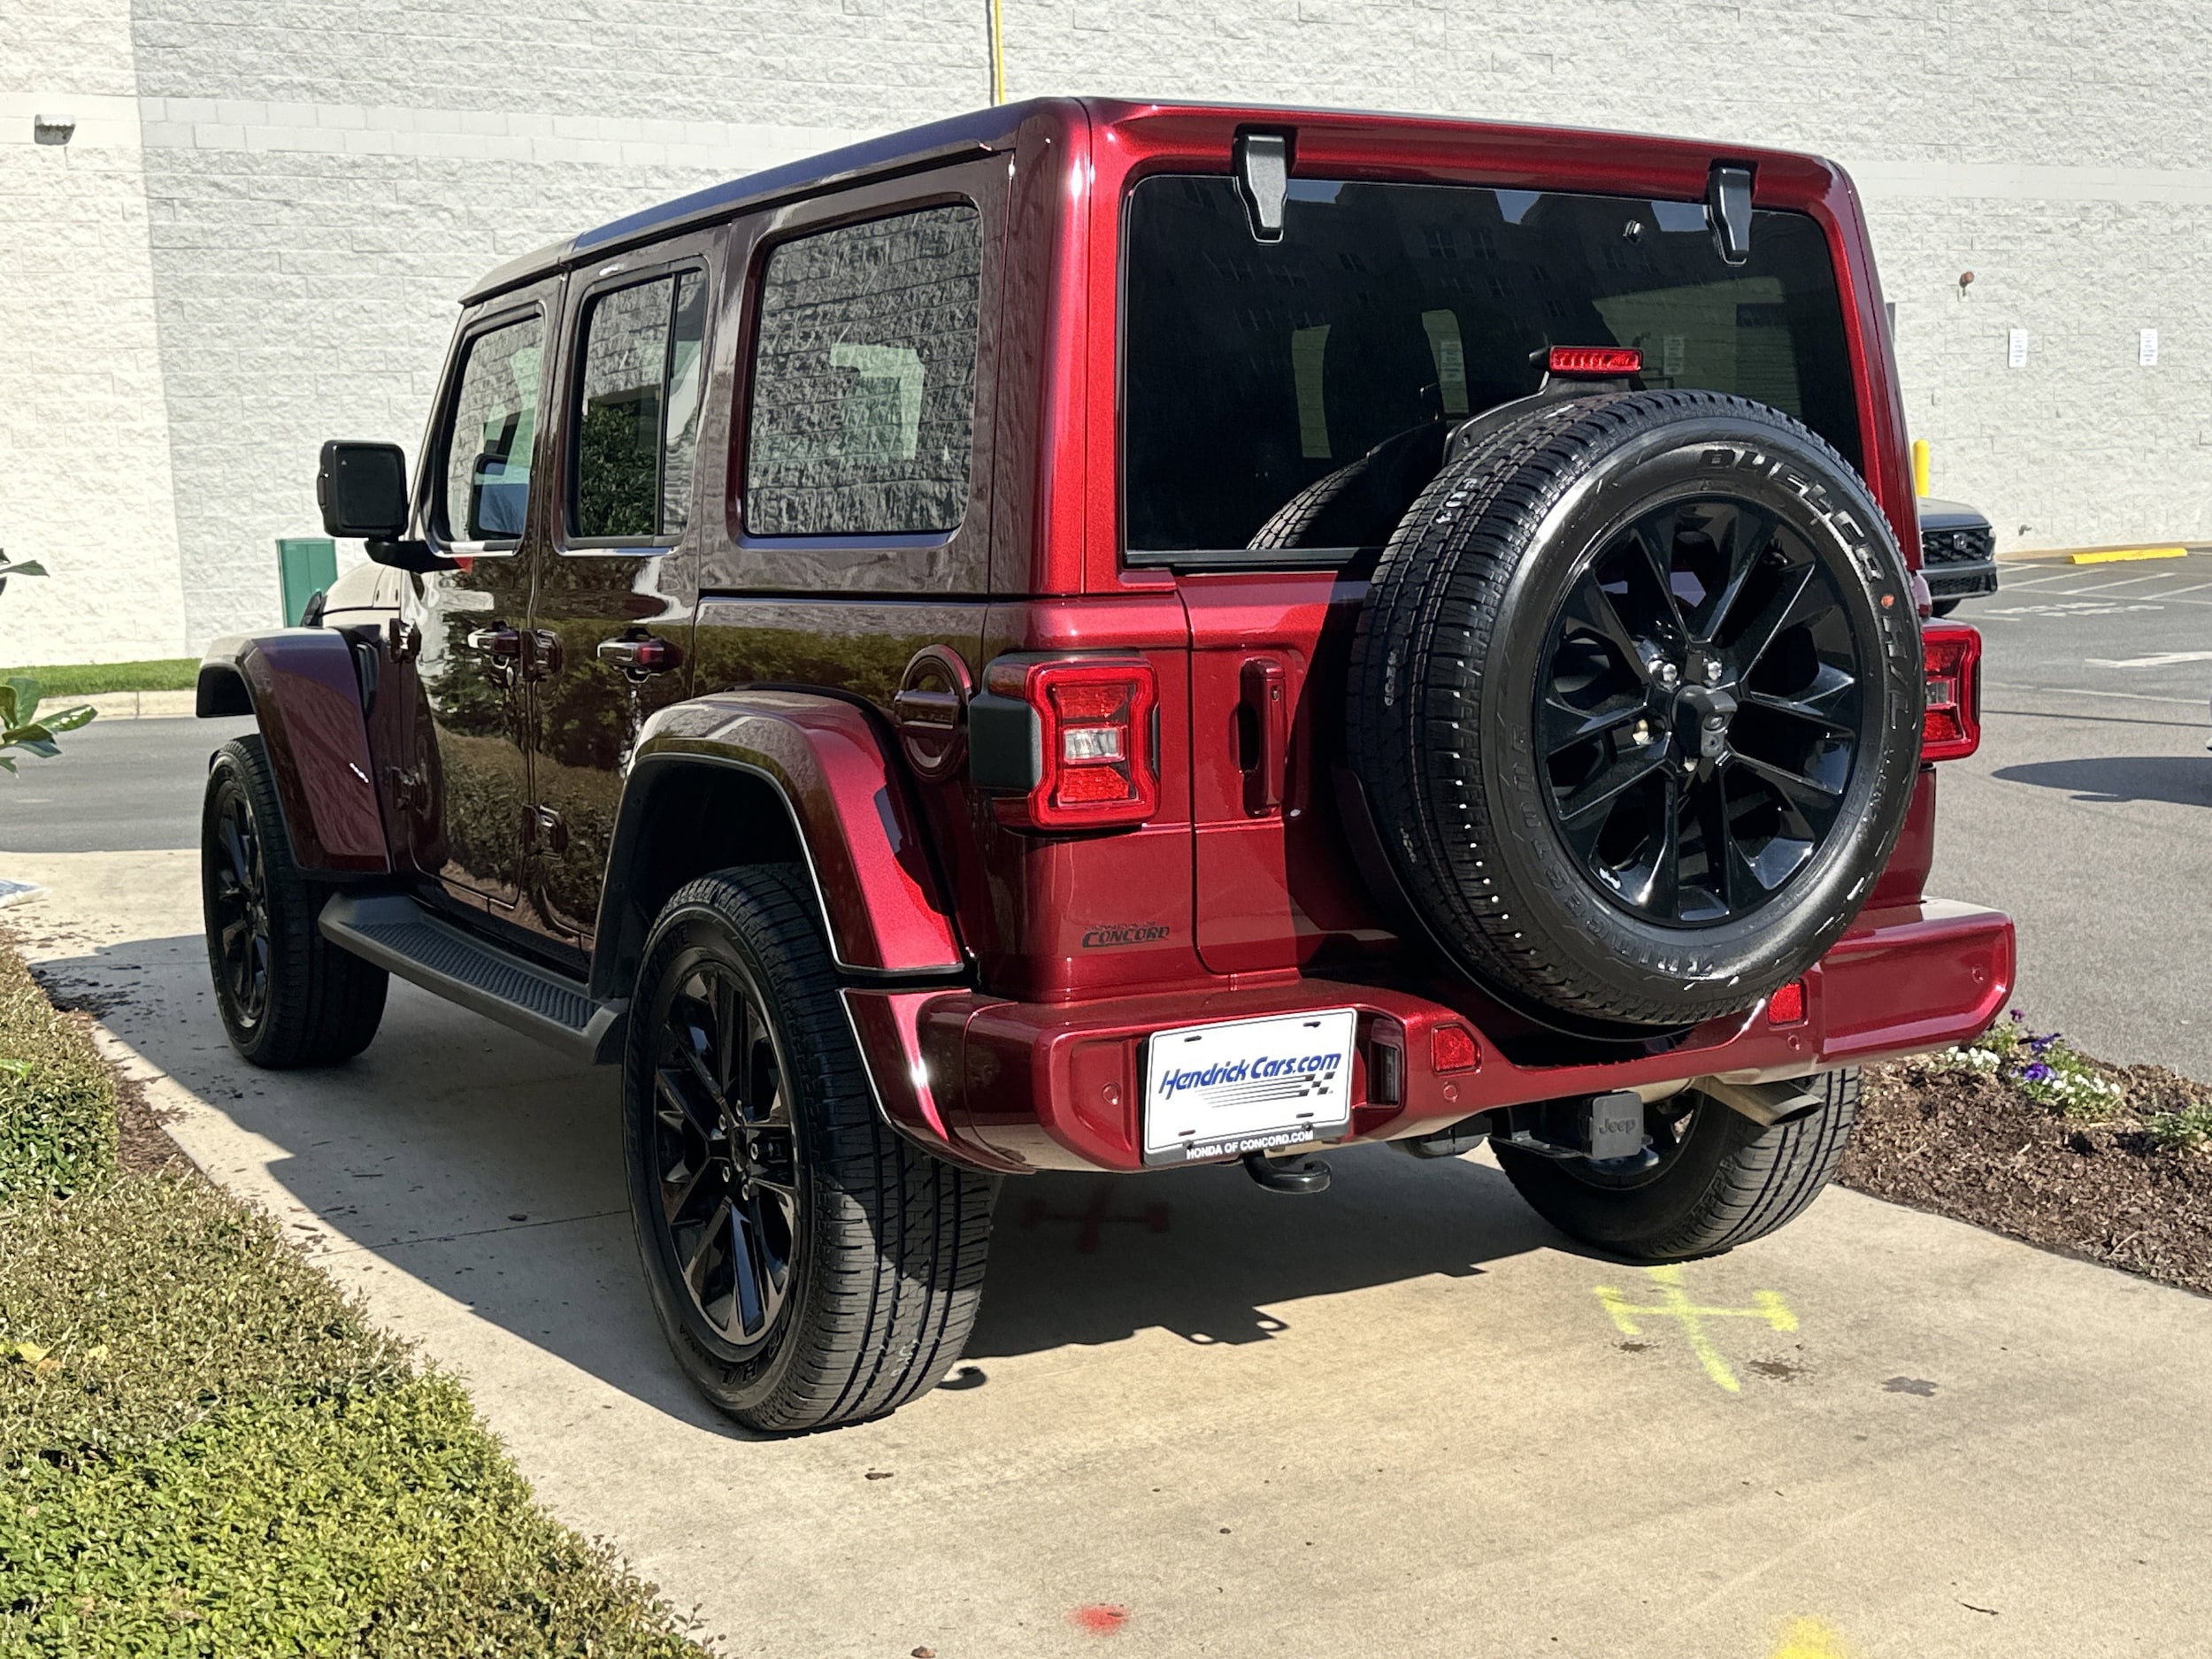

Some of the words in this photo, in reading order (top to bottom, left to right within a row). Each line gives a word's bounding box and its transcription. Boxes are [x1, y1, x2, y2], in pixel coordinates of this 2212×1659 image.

[1700, 449, 1885, 581] DUELER
[1082, 926, 1170, 948] CONCORD
[1599, 1118, 1636, 1134] Jeep
[1186, 1143, 1223, 1160] HONDA
[1225, 1141, 1239, 1153] OF
[1240, 1130, 1314, 1152] CONCORD.COM
